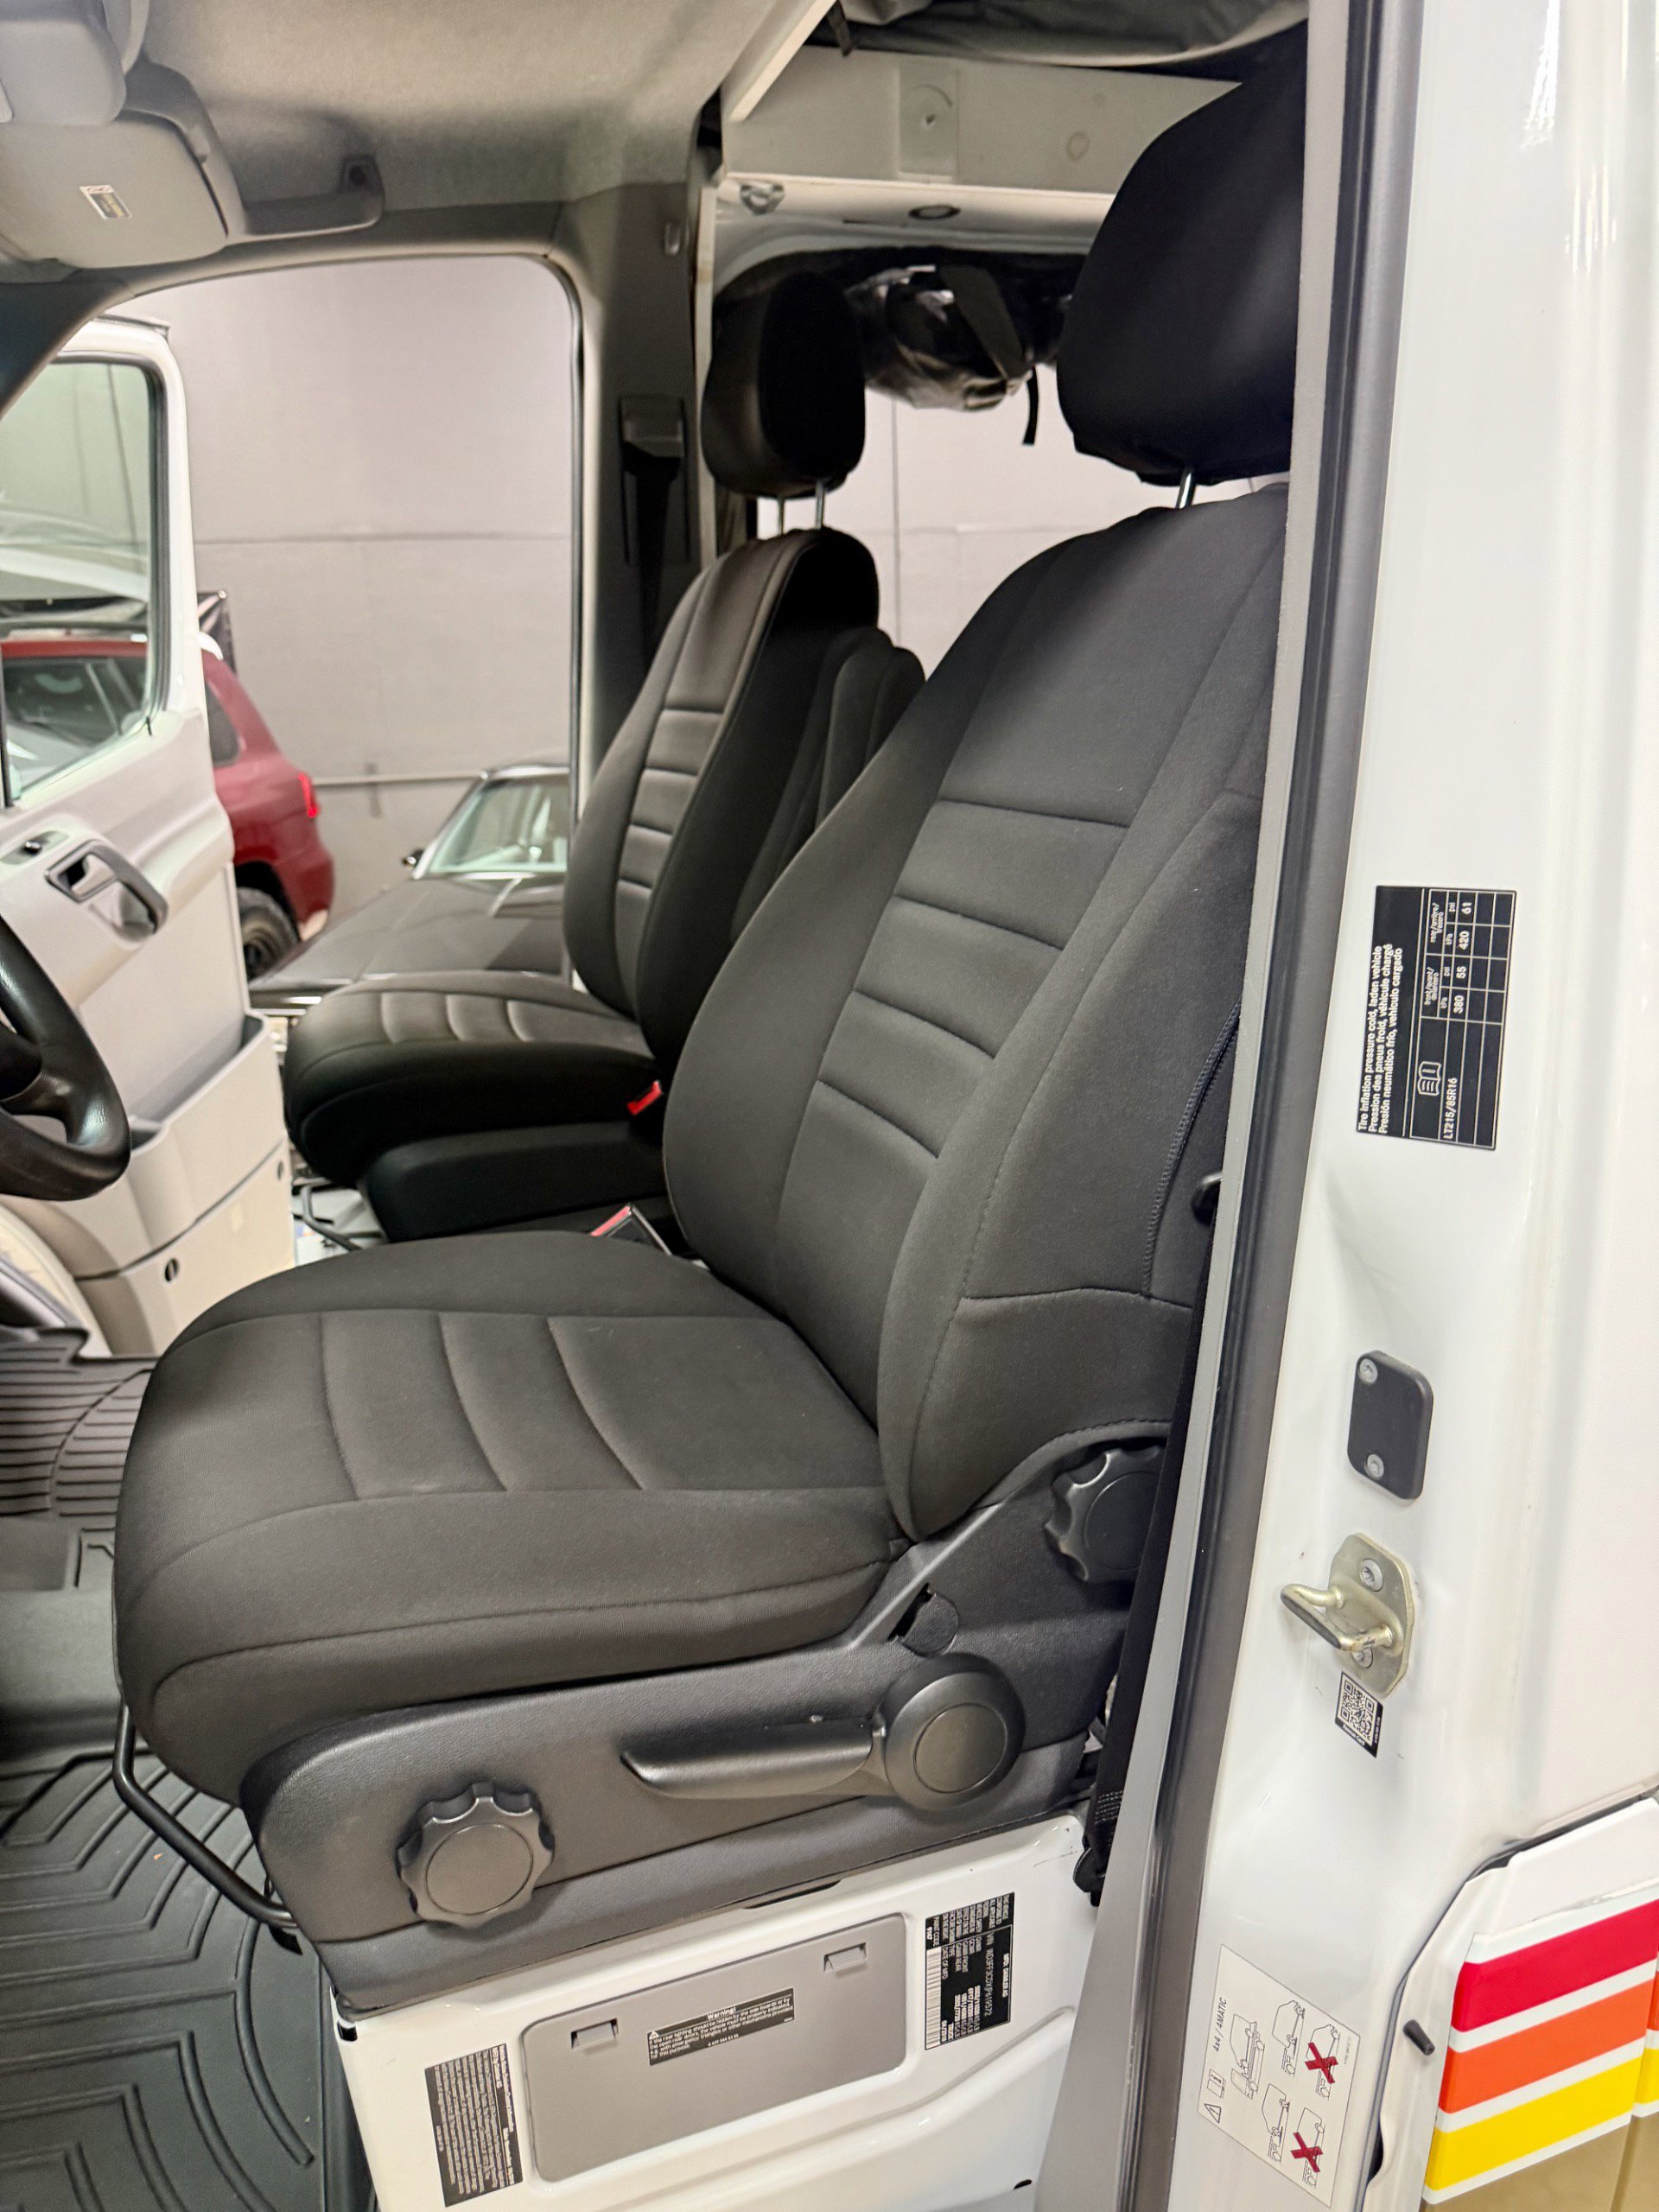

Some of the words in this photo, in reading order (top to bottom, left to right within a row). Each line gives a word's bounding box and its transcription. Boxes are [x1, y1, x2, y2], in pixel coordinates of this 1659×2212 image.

[1461, 901, 1471, 914] 61
[1459, 930, 1469, 950] 420
[1371, 945, 1382, 979] vehicle
[1381, 943, 1394, 976] chargé
[1390, 947, 1404, 987] cargado
[1456, 965, 1466, 979] 55
[1369, 981, 1379, 1006] laden
[1377, 977, 1389, 1016] véhicule
[1453, 995, 1464, 1014] 380
[1367, 1008, 1378, 1031] cold,
[1376, 1018, 1388, 1043] froid,
[1385, 1027, 1397, 1047] frío,
[1364, 1033, 1376, 1072] pressure
[1375, 1044, 1385, 1072] pneus
[1372, 1074, 1382, 1091] des
[1382, 1048, 1394, 1097] neumático
[1360, 1074, 1372, 1111] inflation
[1359, 1112, 1369, 1130] Tire
[1369, 1092, 1380, 1132] Pression
[1378, 1098, 1389, 1134] Presión
[1444, 1077, 1458, 1140] LT215/85R16
[943, 1960, 948, 1968] OF
[708, 2006, 736, 2021] Warning!
[1212, 2035, 1221, 2052] 4x4
[1217, 1997, 1227, 2028] 4MATIC
